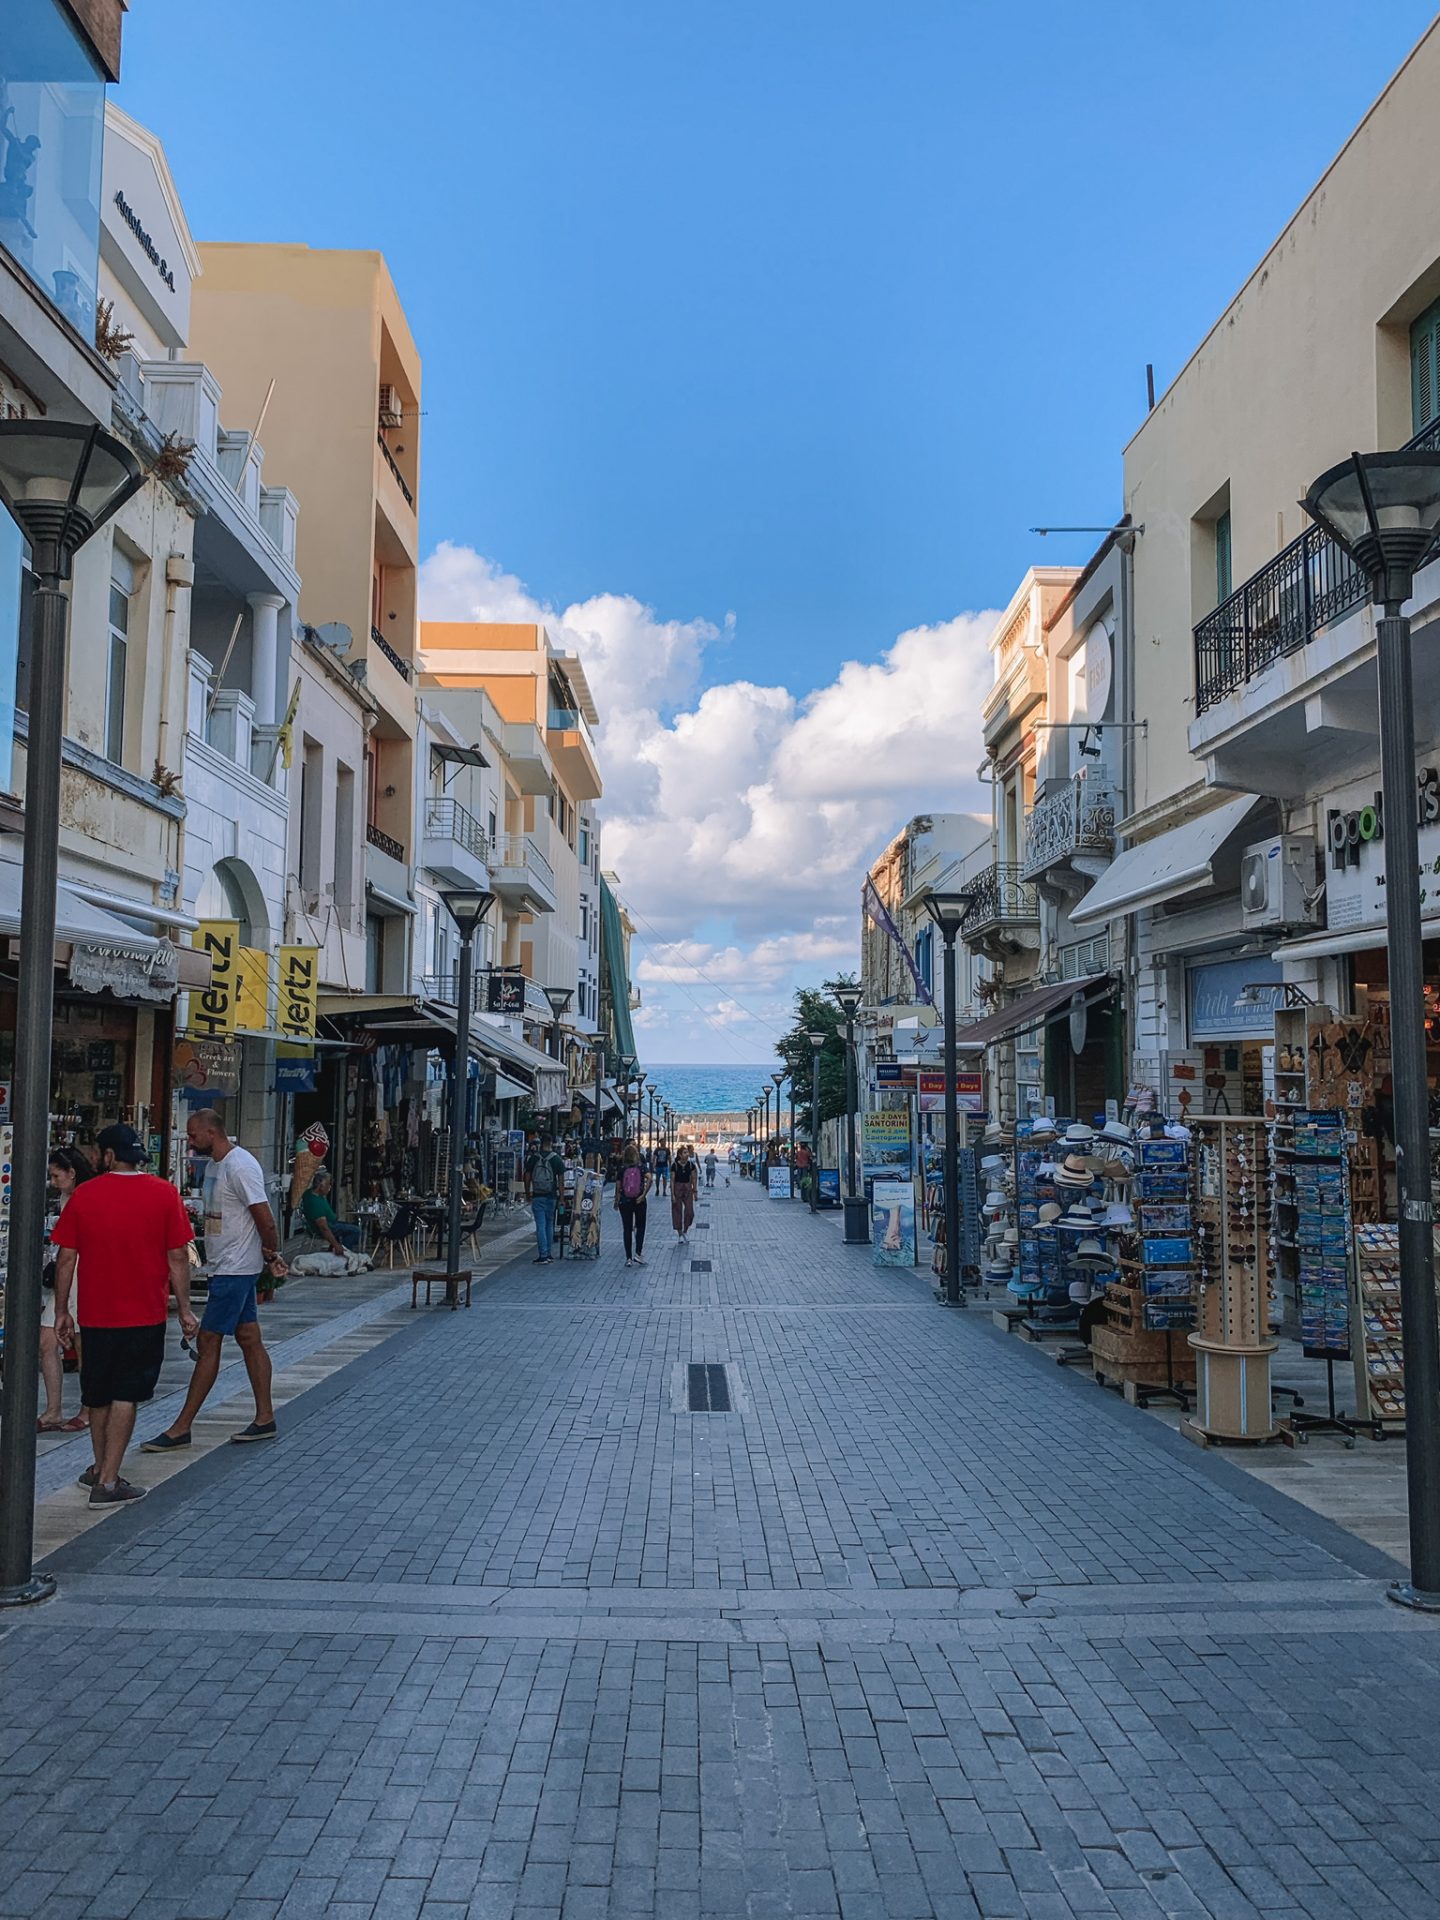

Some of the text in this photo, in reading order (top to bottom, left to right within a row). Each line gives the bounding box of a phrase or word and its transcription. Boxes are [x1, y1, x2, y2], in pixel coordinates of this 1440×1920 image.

[113, 189, 176, 294] Autohellas S.A.
[282, 956, 313, 1048] Hertz
[199, 1053, 235, 1063] Greek art
[212, 1061, 219, 1069] &
[207, 1069, 236, 1078] Flowers
[278, 1067, 311, 1080] Thrifty
[928, 1082, 943, 1090] Day
[960, 1082, 979, 1090] Days
